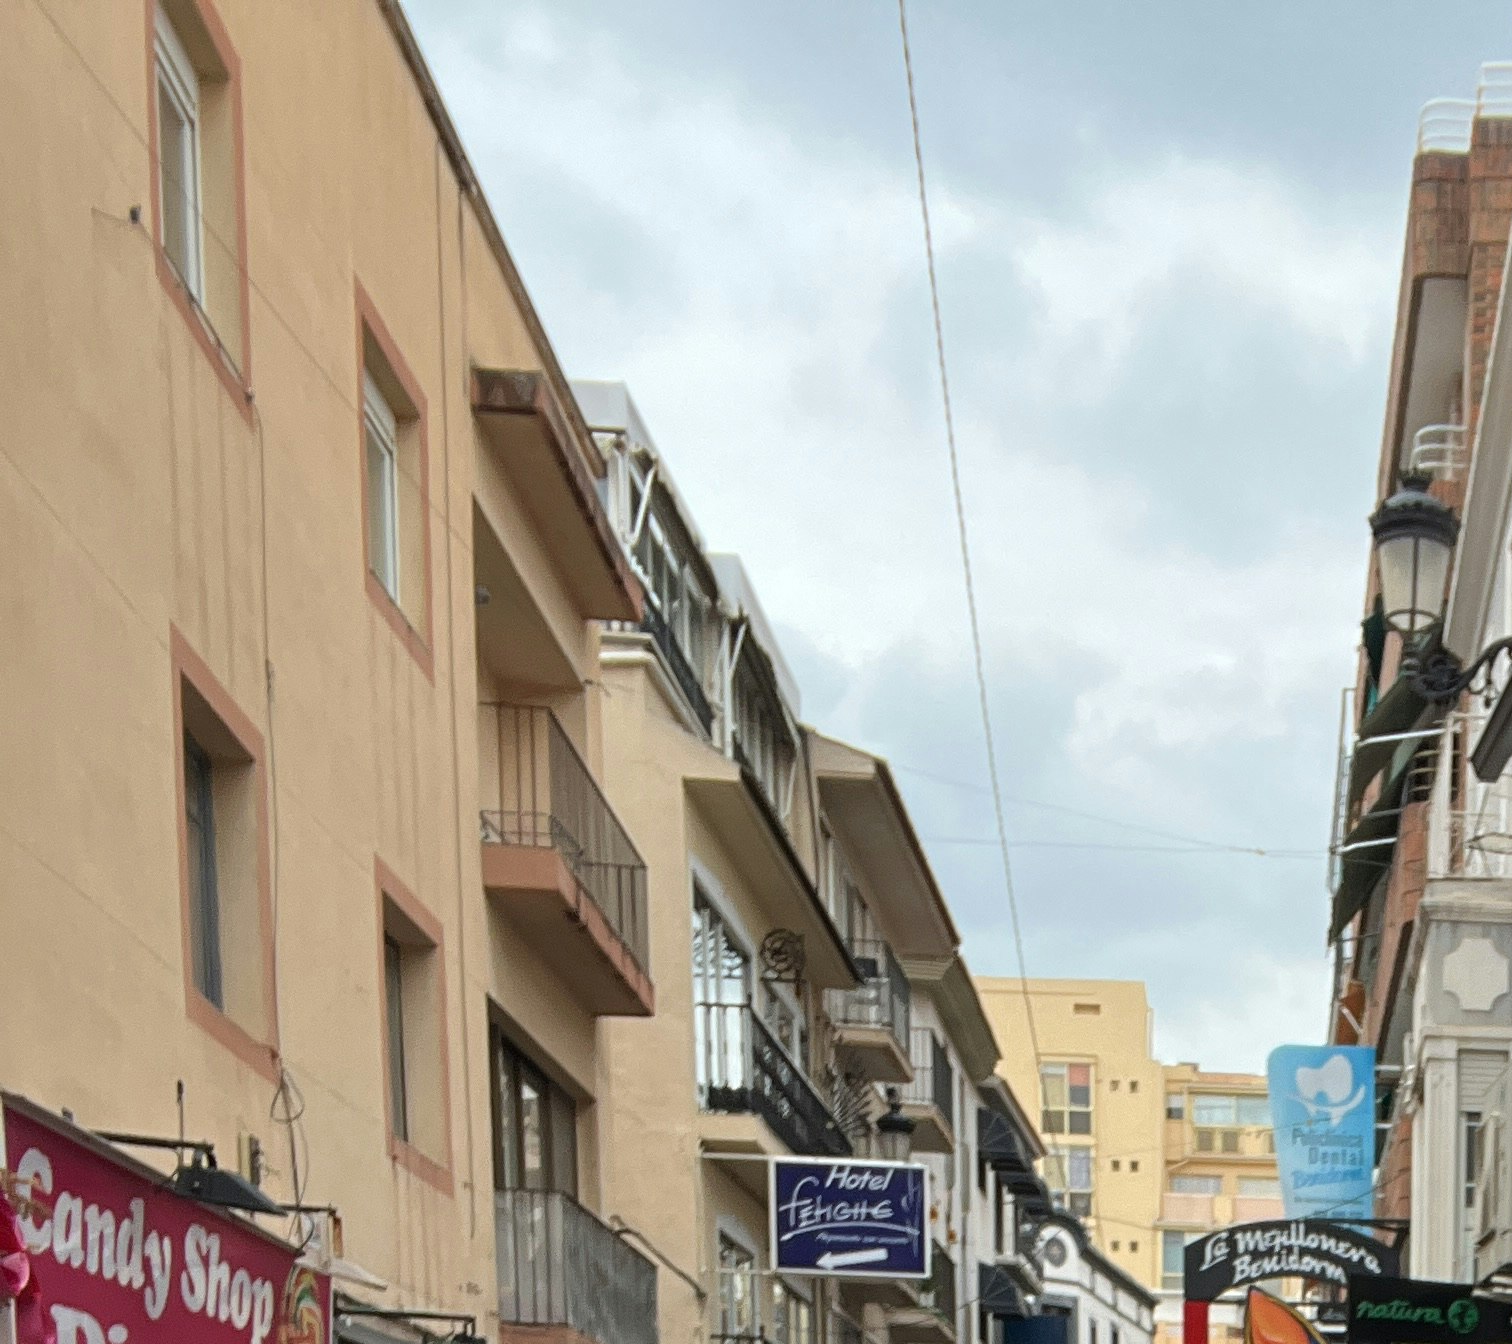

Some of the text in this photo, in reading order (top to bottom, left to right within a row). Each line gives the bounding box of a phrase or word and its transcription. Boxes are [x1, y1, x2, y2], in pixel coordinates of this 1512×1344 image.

[1308, 1147, 1364, 1165] Dental
[825, 1164, 895, 1191] Hotel
[15, 1148, 172, 1320] Candy
[1200, 1231, 1231, 1271] La
